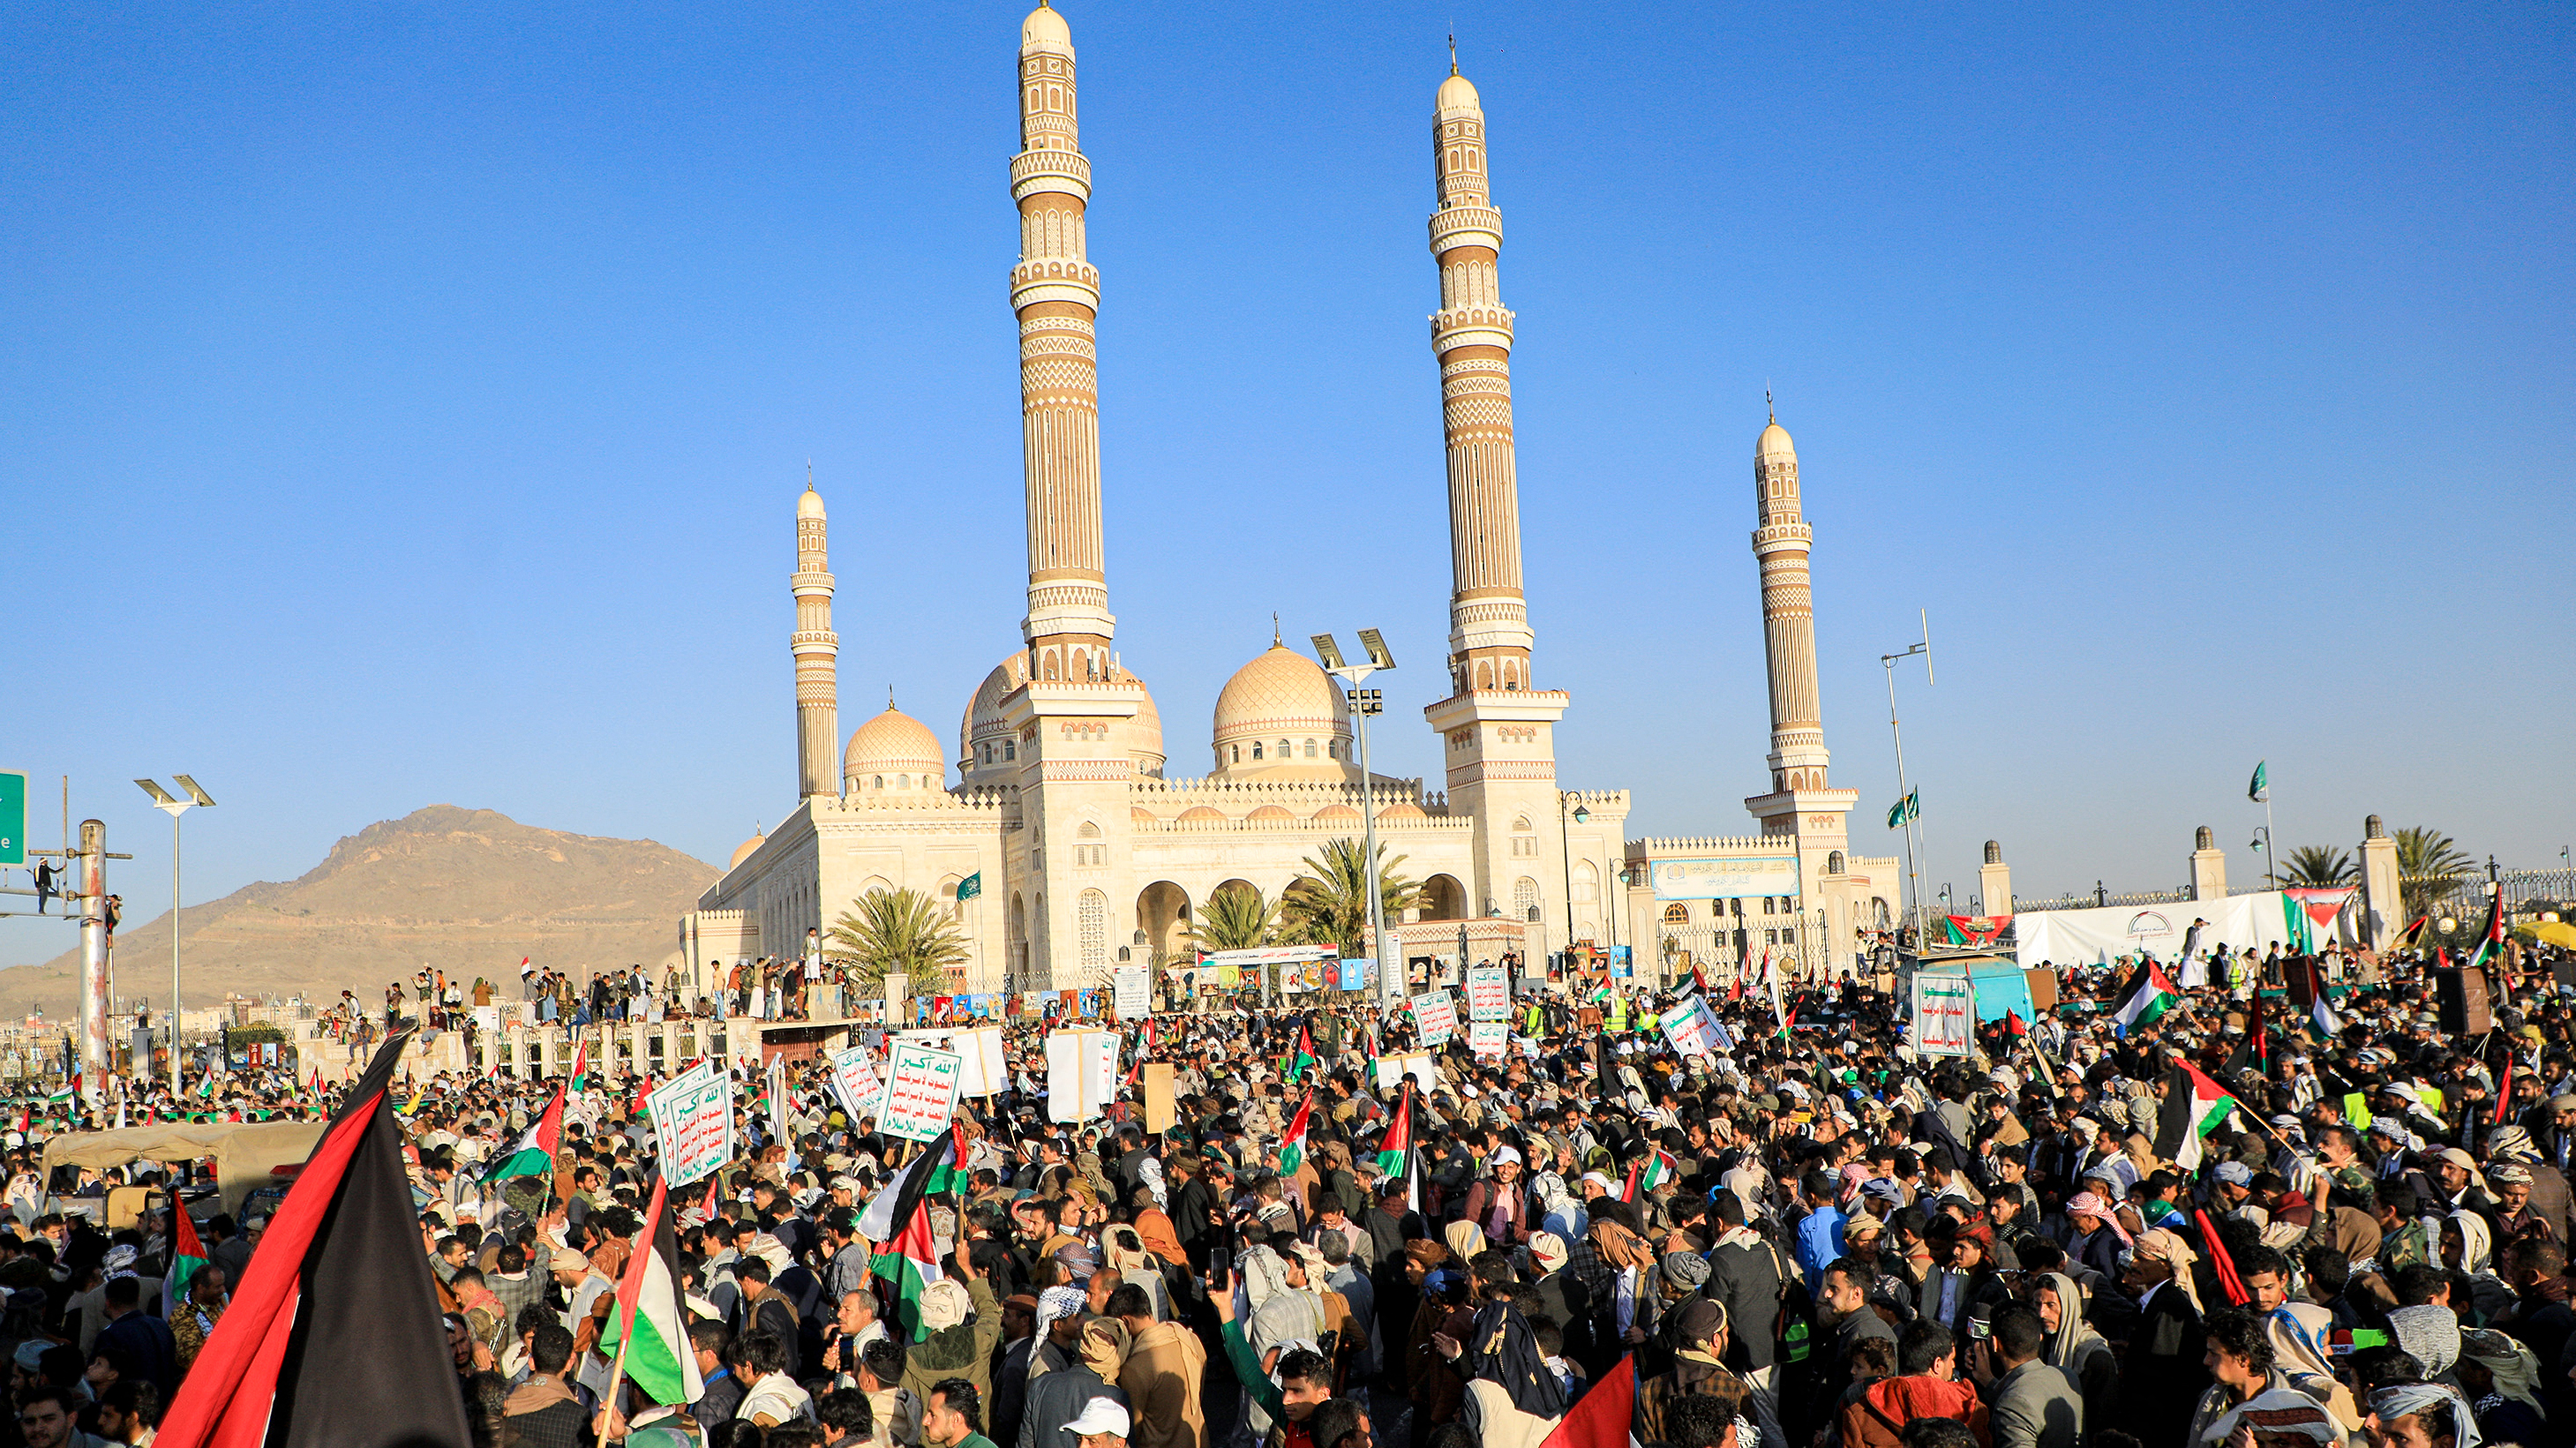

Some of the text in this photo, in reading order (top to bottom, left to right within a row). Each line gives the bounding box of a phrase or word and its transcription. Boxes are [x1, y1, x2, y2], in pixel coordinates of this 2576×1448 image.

[1492, 972, 1503, 980] الله
[1437, 994, 1447, 1003] الله
[1921, 984, 1965, 999] قاطعوا
[1664, 1002, 1701, 1032] قاطعوا
[1922, 1003, 1964, 1018] البضائع الأمريكية
[854, 1052, 863, 1062] الله
[899, 1054, 957, 1074] الله أكبر
[897, 1070, 953, 1091] الموت لأمريكا
[705, 1084, 724, 1103] الله
[893, 1086, 950, 1106] الموت لإسرائيل
[677, 1091, 702, 1122] أكبر
[702, 1104, 725, 1121] الموت
[890, 1103, 947, 1122] اللعنة على اليهود
[702, 1119, 726, 1136] الموت
[885, 1117, 944, 1137] النصر للإسلام
[709, 1134, 725, 1148] اللعنة
[679, 1148, 725, 1182] النصر للإسلام
[680, 1149, 695, 1167] اليهود
